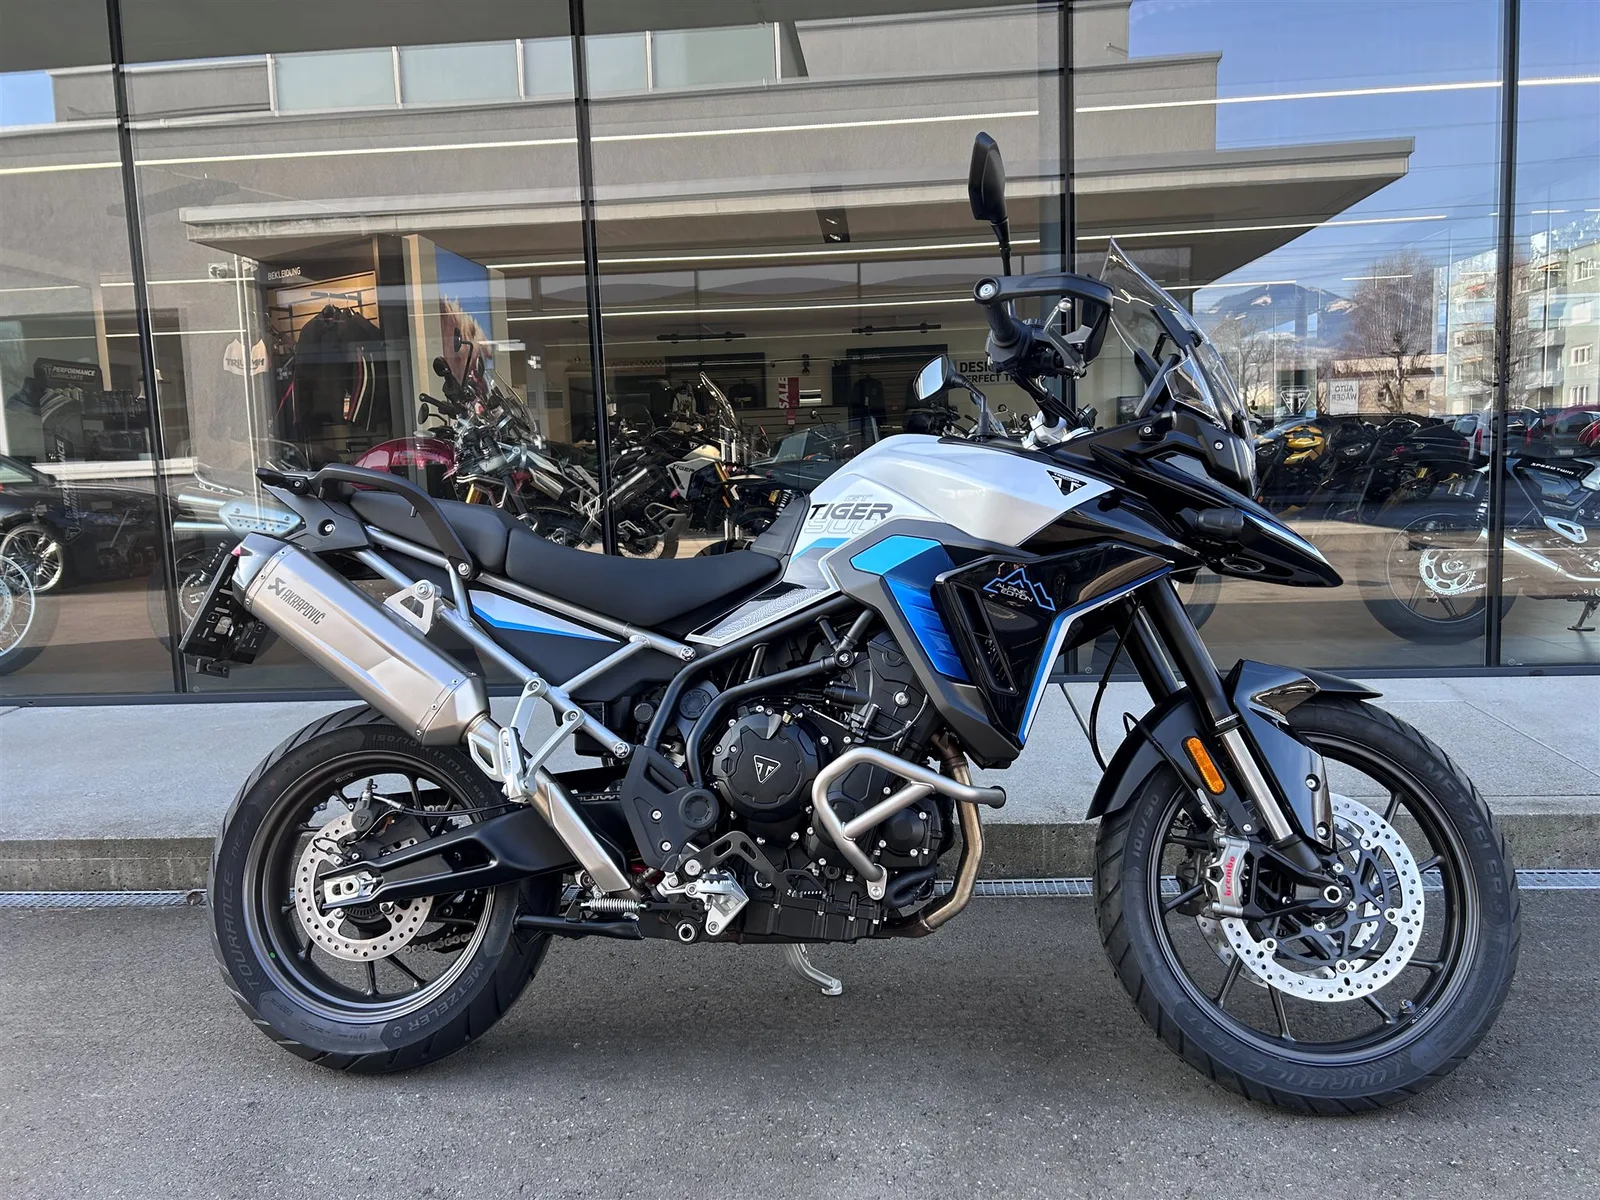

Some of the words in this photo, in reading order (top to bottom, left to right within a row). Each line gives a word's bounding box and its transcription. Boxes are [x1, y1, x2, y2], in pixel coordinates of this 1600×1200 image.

[267, 267, 301, 280] BEKLEIDUNG
[52, 366, 96, 377] PERFORMANCE
[966, 373, 1001, 383] ERFECT
[778, 376, 790, 409] SALE
[809, 502, 893, 520] TIGER
[1223, 856, 1236, 897] brembo
[408, 962, 485, 1032] METZELER
